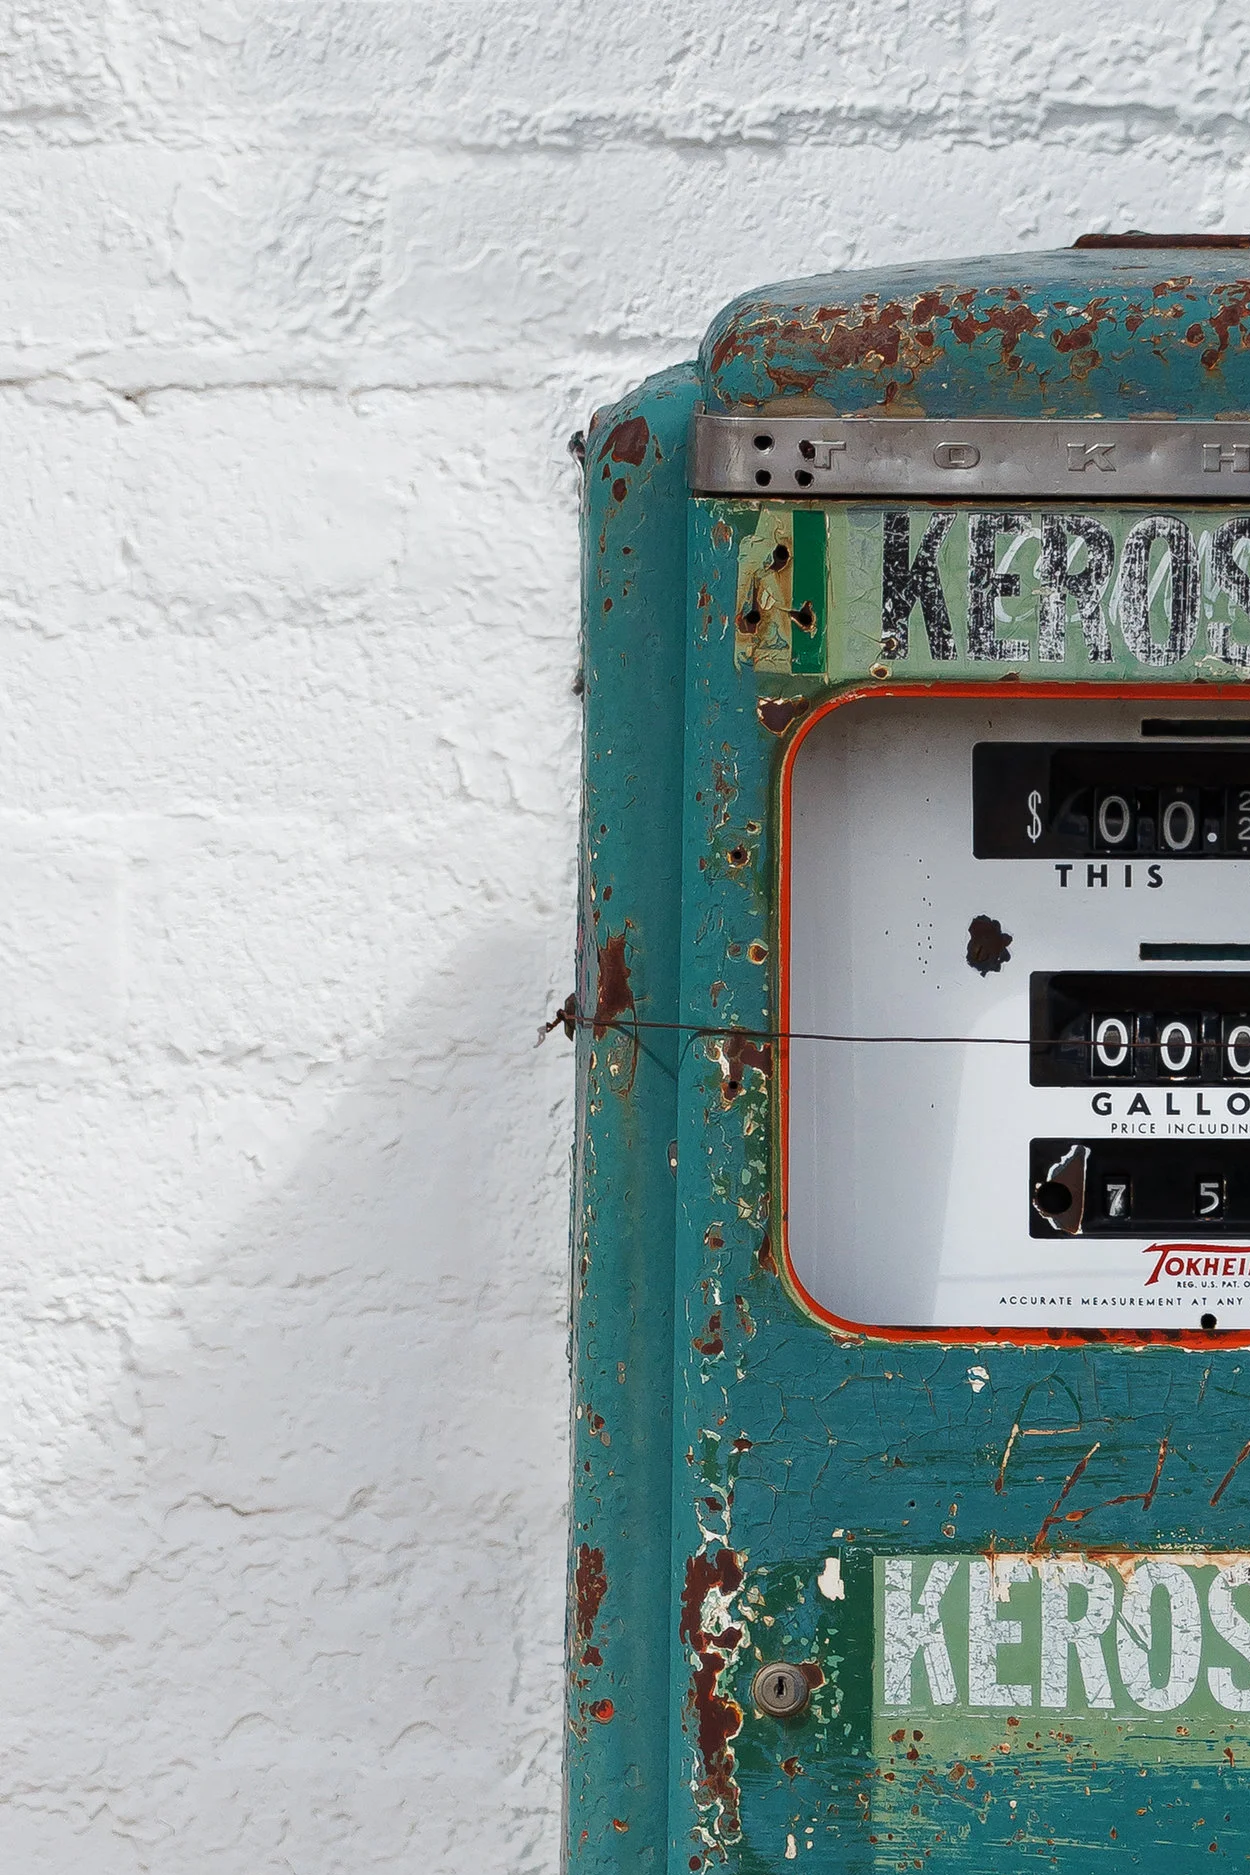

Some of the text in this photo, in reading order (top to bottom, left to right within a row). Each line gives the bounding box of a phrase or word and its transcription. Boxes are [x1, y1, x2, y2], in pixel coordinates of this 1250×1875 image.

[1054, 864, 1164, 889] THIS
[1110, 1122, 1157, 1135] PRICE
[1176, 1280, 1198, 1289] REG.
[1201, 1280, 1218, 1289] U.S.
[1221, 1280, 1240, 1289] PAT.
[999, 1296, 1073, 1306] ACCURATE
[1081, 1296, 1182, 1306] MEASUREMENT
[1191, 1296, 1208, 1306] AT
[1216, 1296, 1243, 1306] ANY
